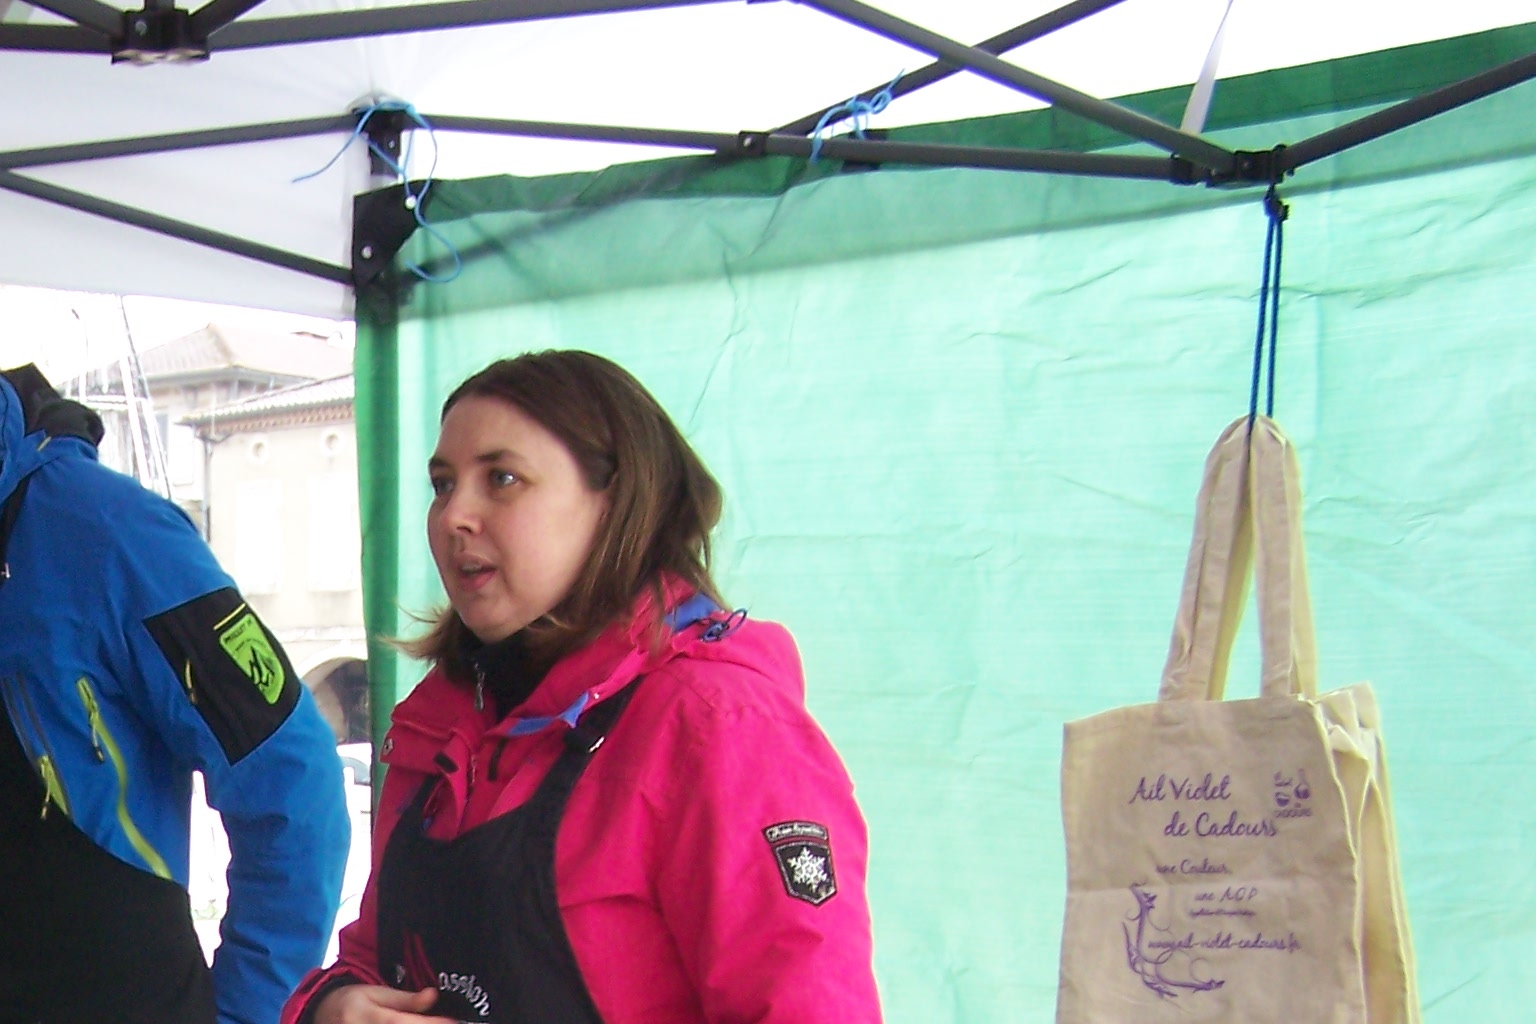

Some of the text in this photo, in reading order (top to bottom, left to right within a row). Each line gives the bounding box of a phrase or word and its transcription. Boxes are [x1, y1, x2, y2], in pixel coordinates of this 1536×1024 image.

[1128, 773, 1166, 804] Ail
[1163, 810, 1191, 837] de
[1195, 810, 1279, 837] Cadours
